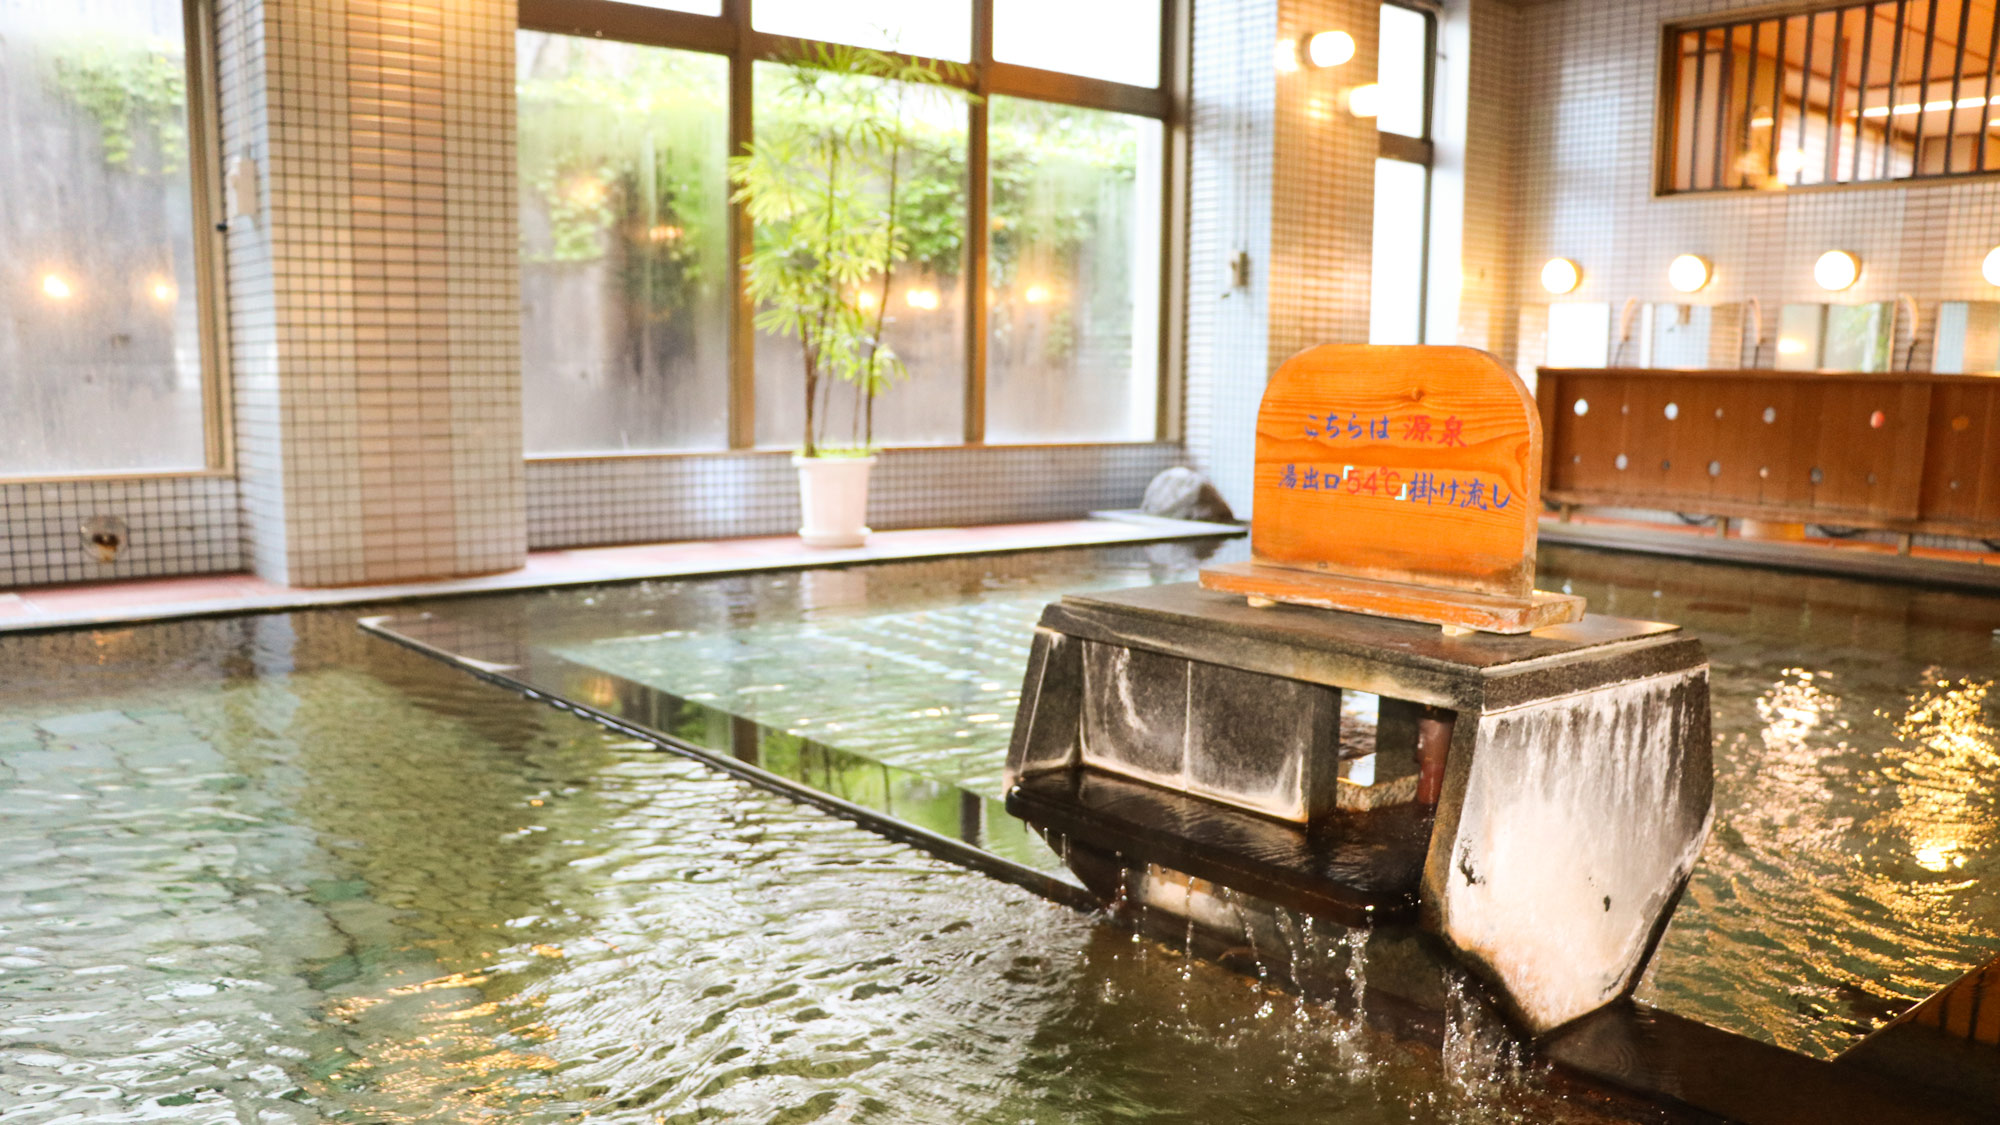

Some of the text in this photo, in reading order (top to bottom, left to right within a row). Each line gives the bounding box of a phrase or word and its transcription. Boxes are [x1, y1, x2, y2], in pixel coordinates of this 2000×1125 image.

[1304, 411, 1468, 448] こちらは 源泉
